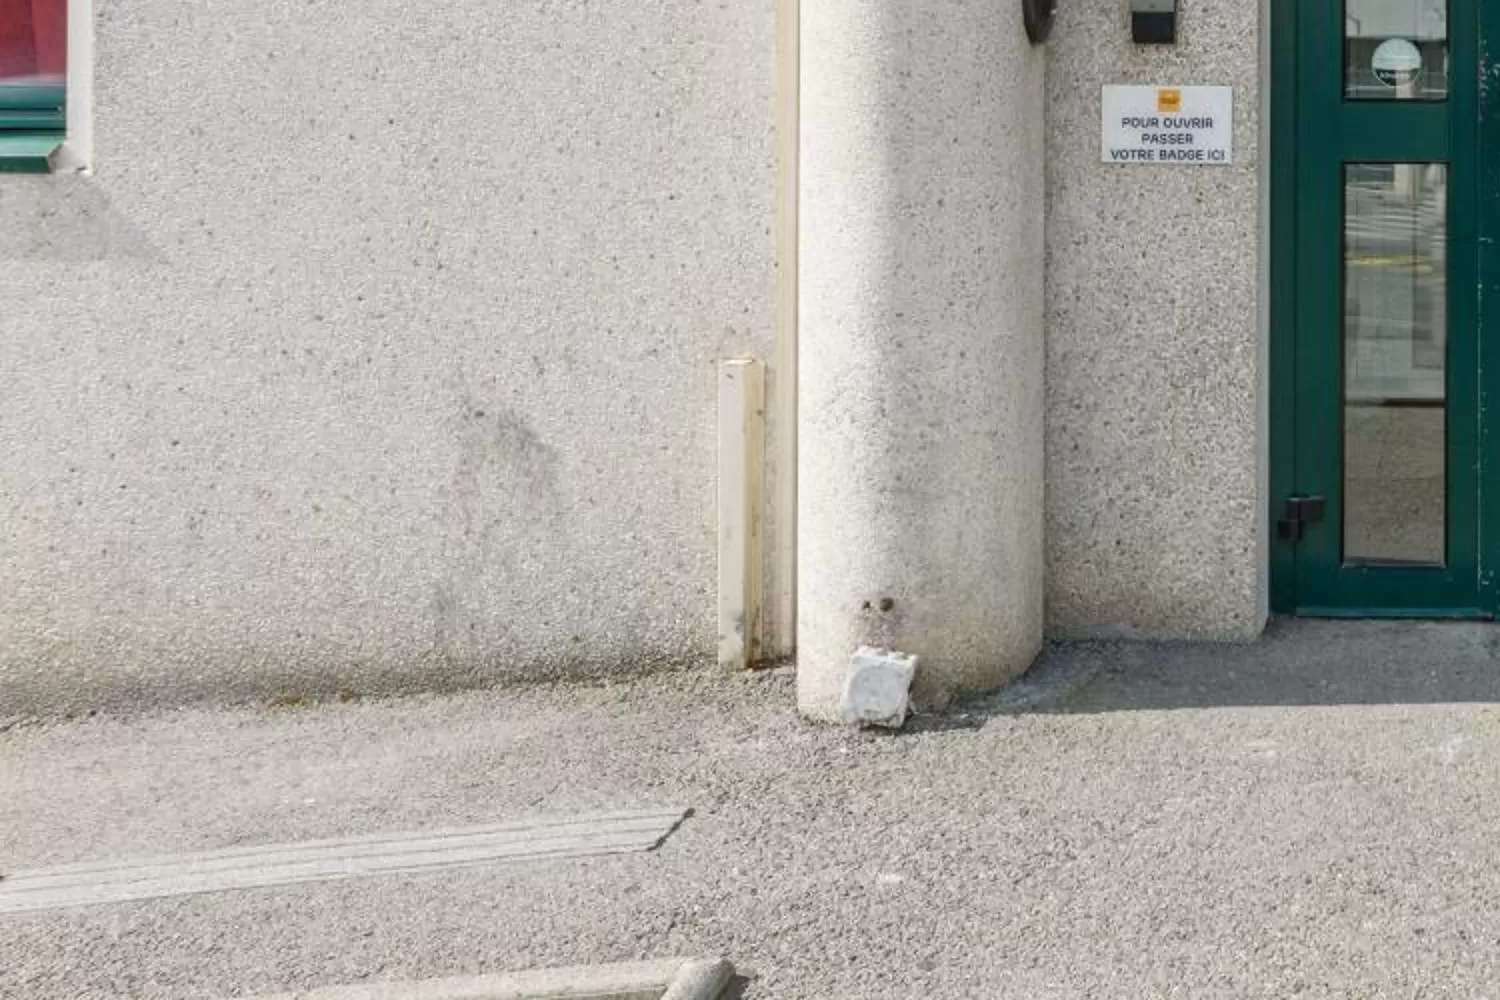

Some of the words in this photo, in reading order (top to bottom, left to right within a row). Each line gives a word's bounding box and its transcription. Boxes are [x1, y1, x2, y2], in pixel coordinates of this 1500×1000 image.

[1121, 117, 1159, 129] POUR
[1163, 117, 1214, 129] OUVRIR
[1141, 133, 1194, 145] PASSER
[1110, 149, 1155, 160] VOTRE
[1159, 149, 1205, 160] BADGE
[1207, 149, 1225, 160] ICI
